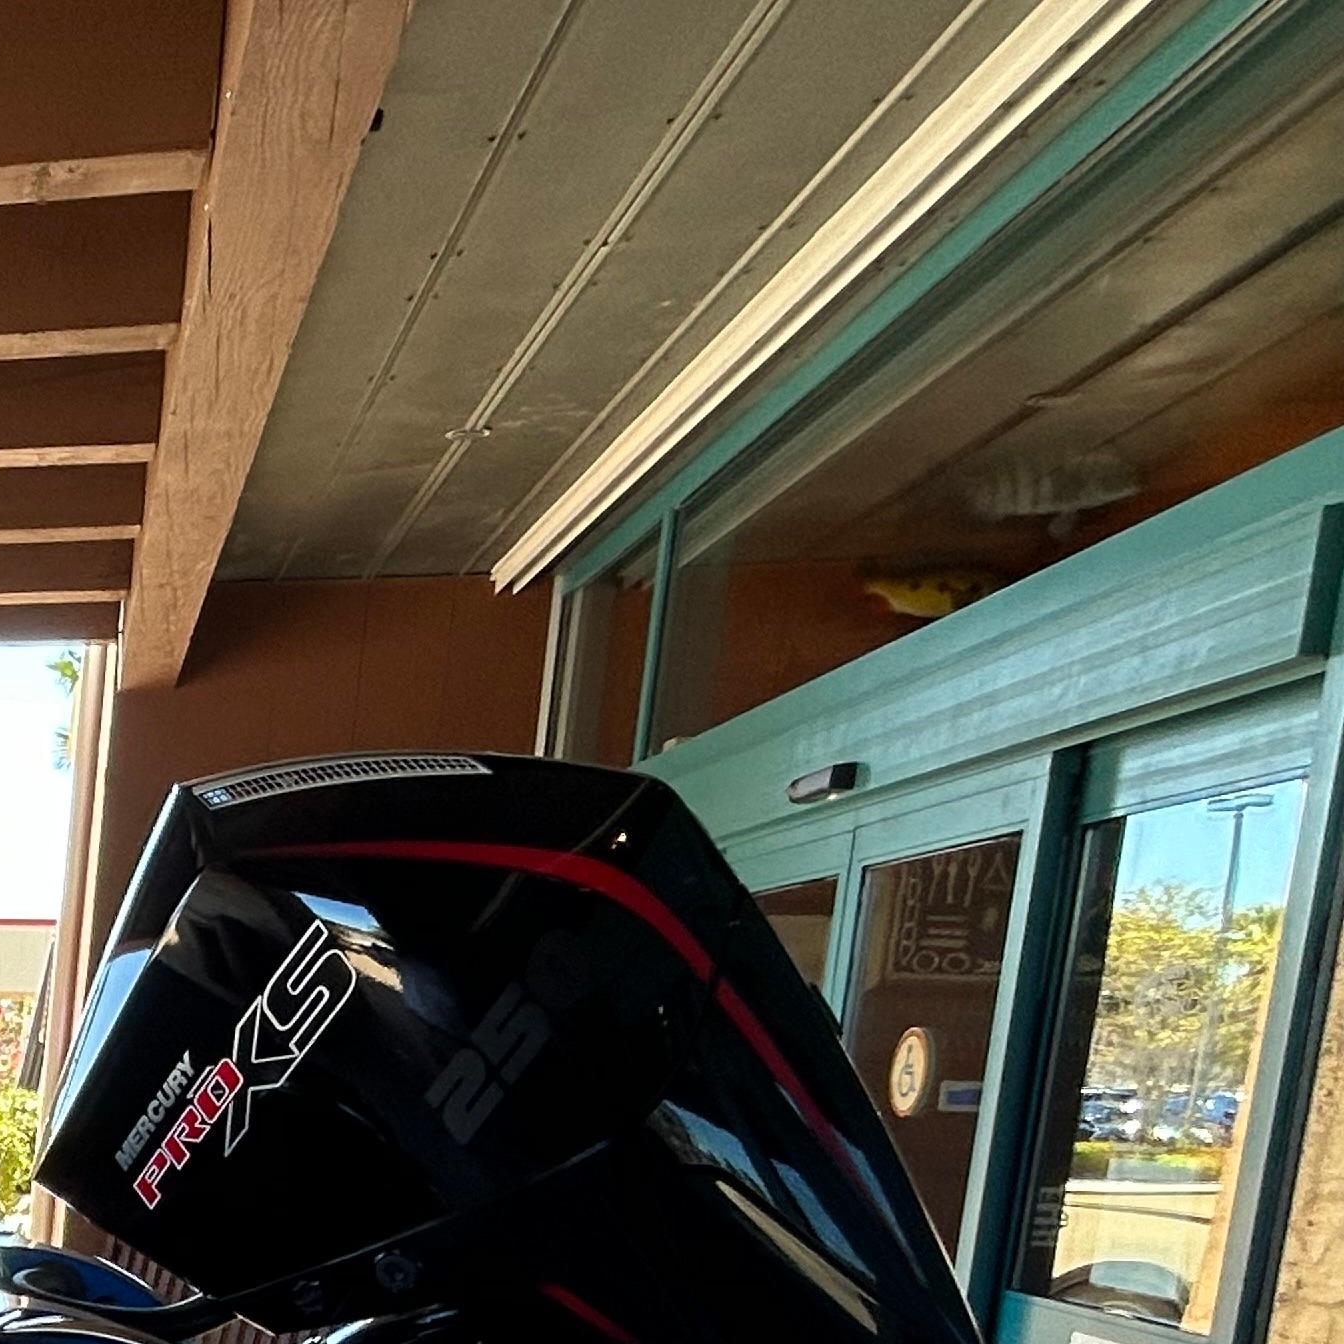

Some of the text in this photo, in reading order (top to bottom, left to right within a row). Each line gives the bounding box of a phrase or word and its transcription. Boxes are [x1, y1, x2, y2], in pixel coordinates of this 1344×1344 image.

[115, 1050, 195, 1171] MERCURY
[133, 919, 357, 1210] PRO XS
